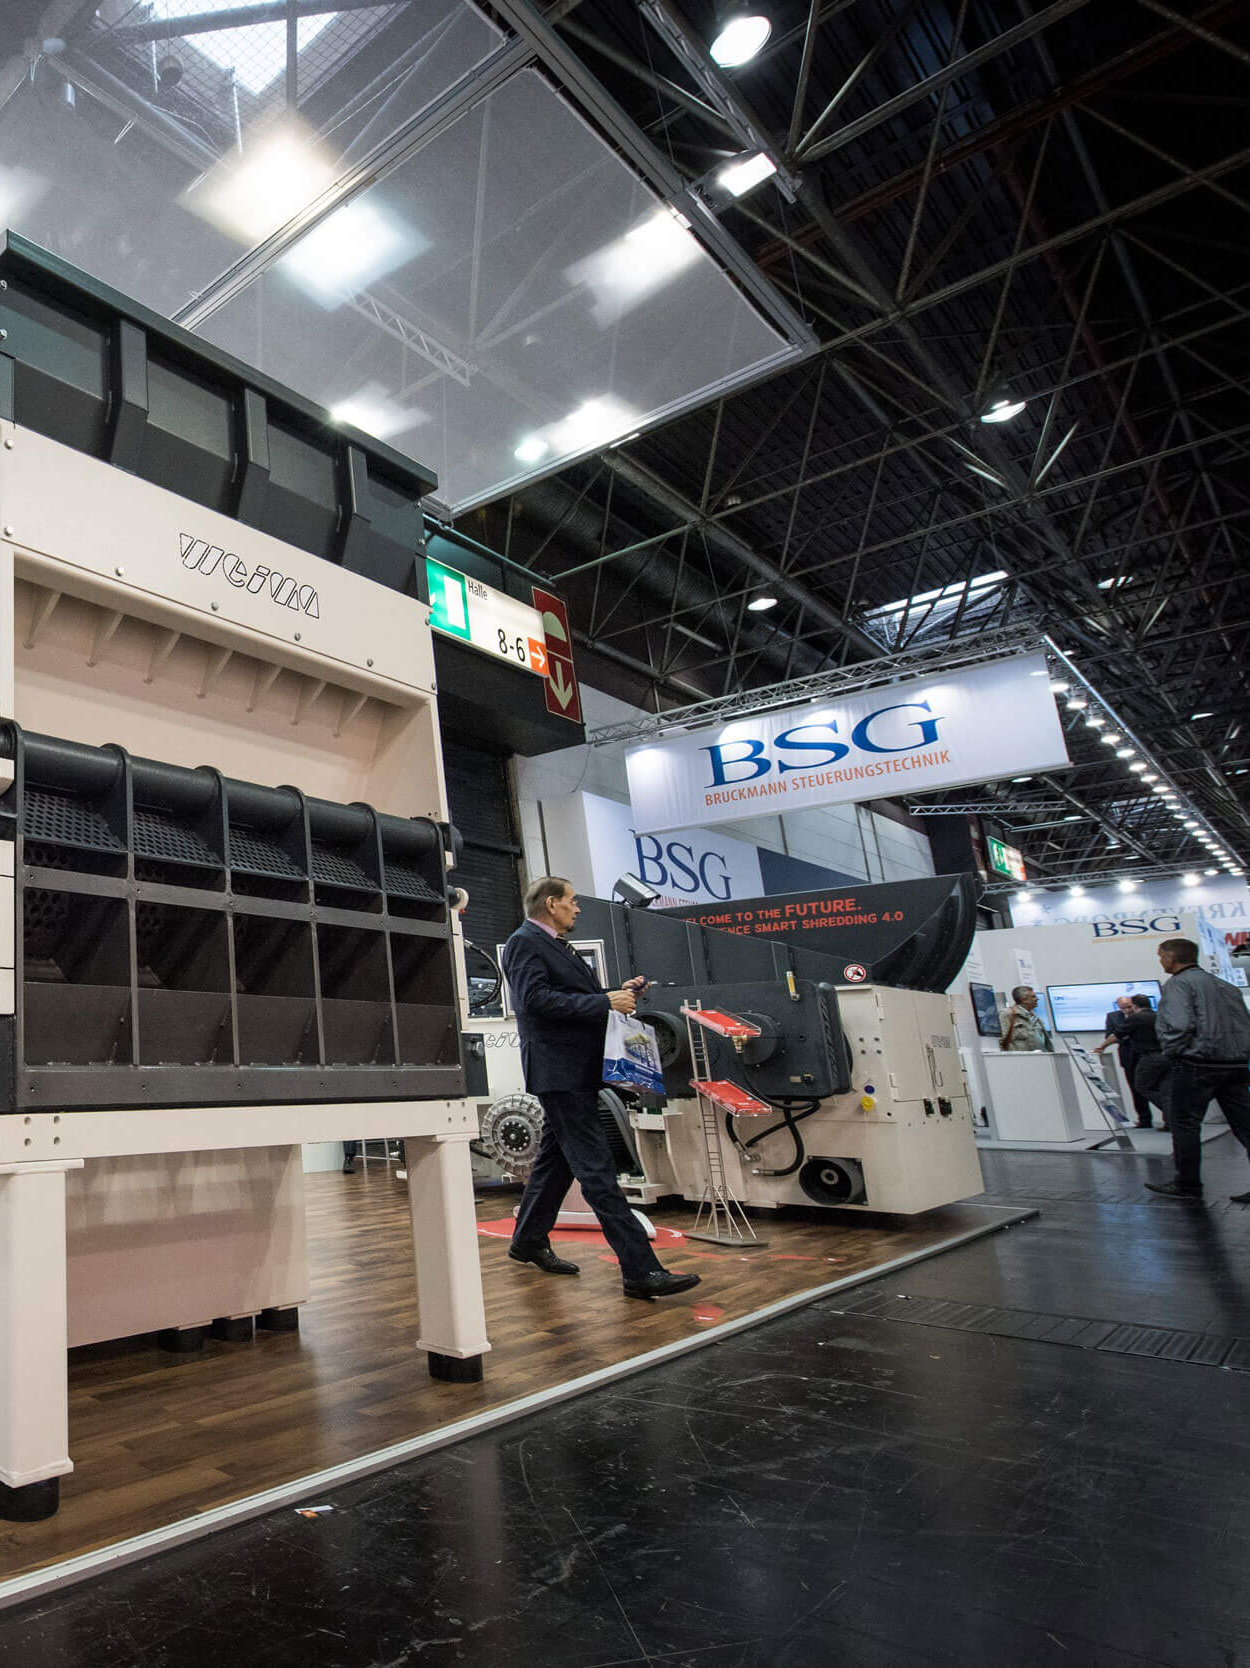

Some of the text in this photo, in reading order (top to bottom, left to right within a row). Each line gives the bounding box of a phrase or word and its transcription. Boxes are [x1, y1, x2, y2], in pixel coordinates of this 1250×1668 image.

[468, 580, 488, 600] Halle
[497, 628, 526, 662] 8-6
[699, 700, 946, 788] BSG
[705, 750, 951, 806] BRUCKMANN STEUERUNGSTECHNIK
[629, 829, 732, 900] BSG
[735, 911, 754, 922] TO
[758, 908, 782, 919] THE
[785, 898, 862, 917] FUTURE.
[755, 919, 798, 934] SMART
[802, 912, 877, 929] SHREDDING
[882, 911, 904, 922] 4.0
[1090, 916, 1182, 937] BSG
